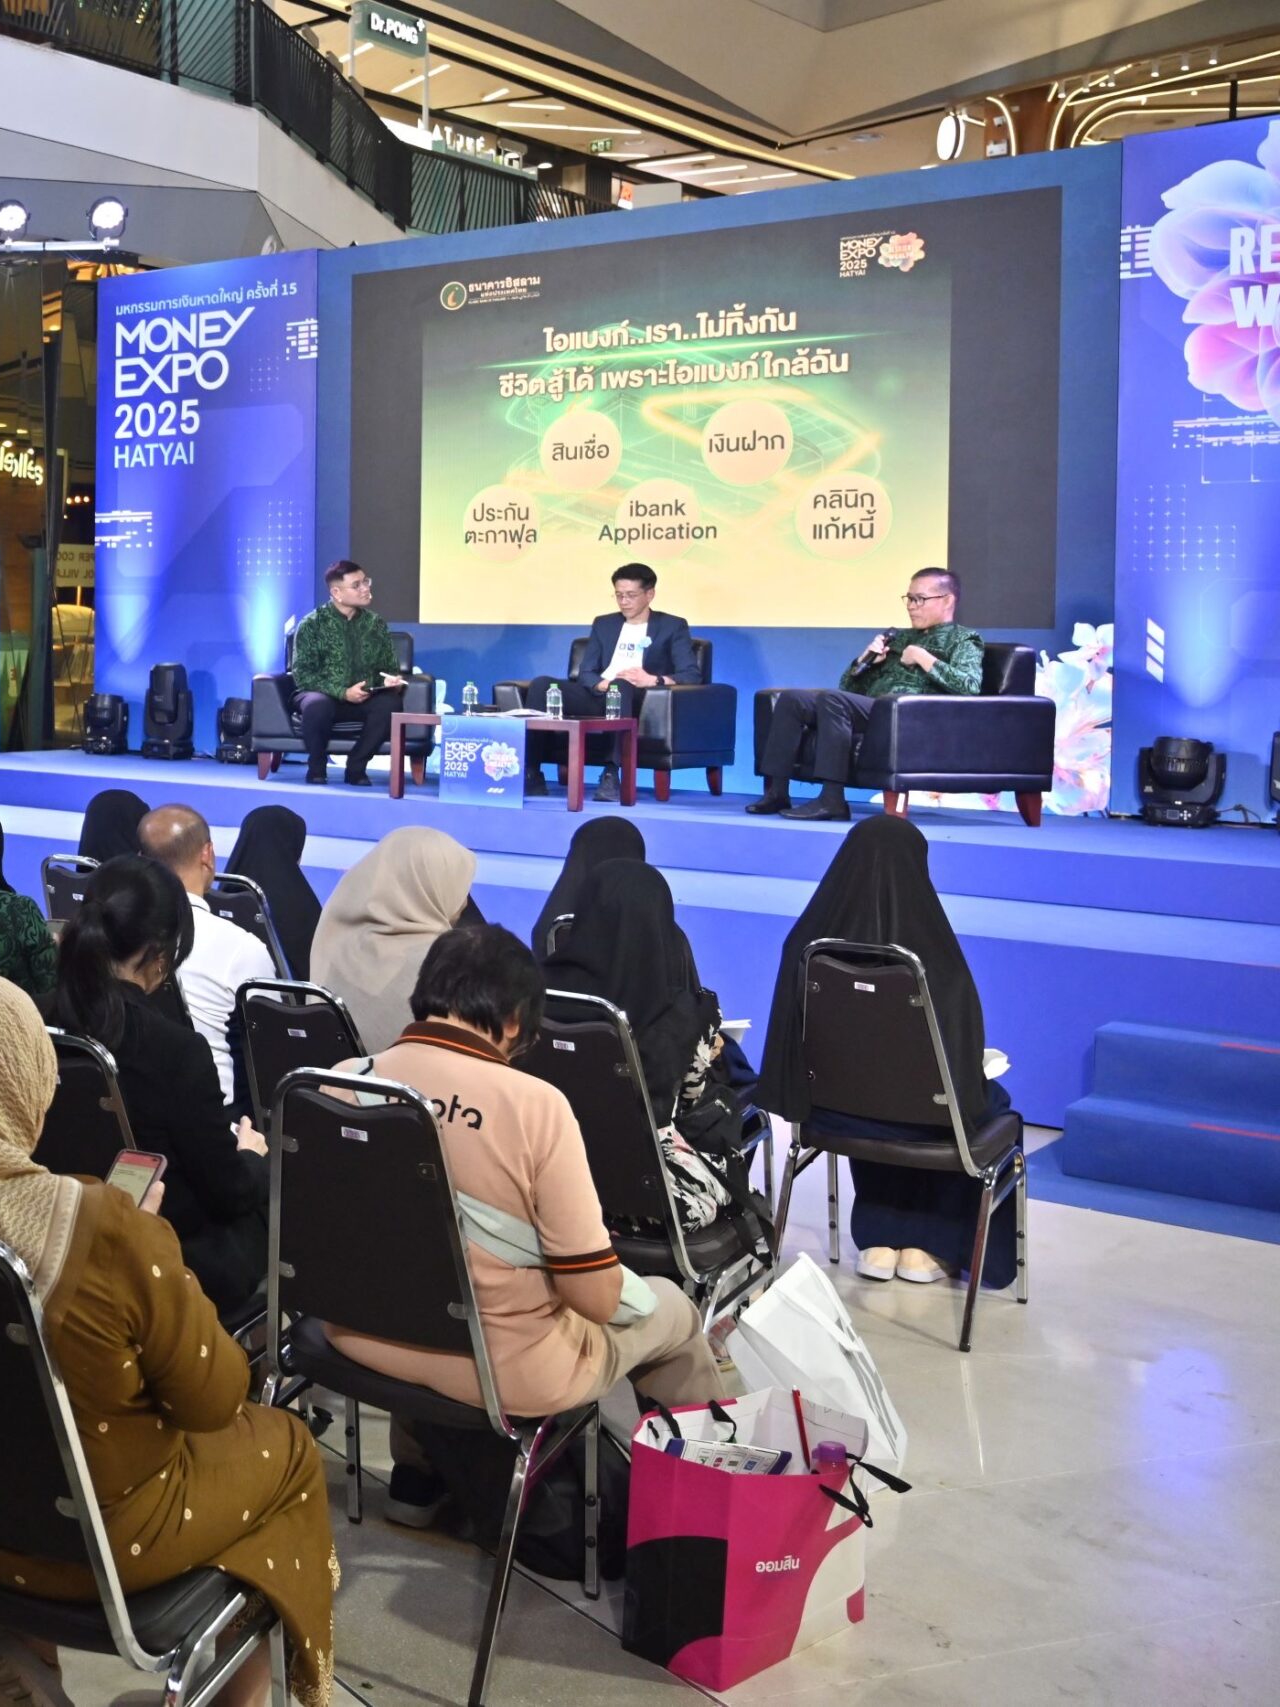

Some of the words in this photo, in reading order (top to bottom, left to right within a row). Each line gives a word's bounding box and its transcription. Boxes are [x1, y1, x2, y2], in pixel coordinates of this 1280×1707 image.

[840, 237, 883, 251] MONEY
[840, 248, 876, 260] EXPO
[840, 259, 867, 271] 2025
[116, 287, 243, 315] มหกรรมการเงินหาดใหญ่
[247, 279, 278, 300] ครั้งที่
[281, 282, 297, 296] 15
[116, 306, 255, 357] MONEY
[115, 350, 229, 398] EXPO
[114, 399, 200, 439] 2025
[114, 441, 195, 468] HATYAI
[551, 434, 610, 462] สินเชื่อ
[708, 432, 785, 455] เงินฝาก
[630, 500, 685, 518] ibank
[813, 488, 875, 510] คลินิก
[473, 501, 529, 523] ประกัน
[598, 522, 717, 545] Application
[813, 511, 876, 540] แก้หนี้
[464, 525, 537, 550] ตะกาฟุล
[445, 741, 483, 752] MONEY
[445, 751, 476, 762] EXPO
[444, 761, 469, 771] 2025
[755, 1555, 800, 1573] ออมสิน
